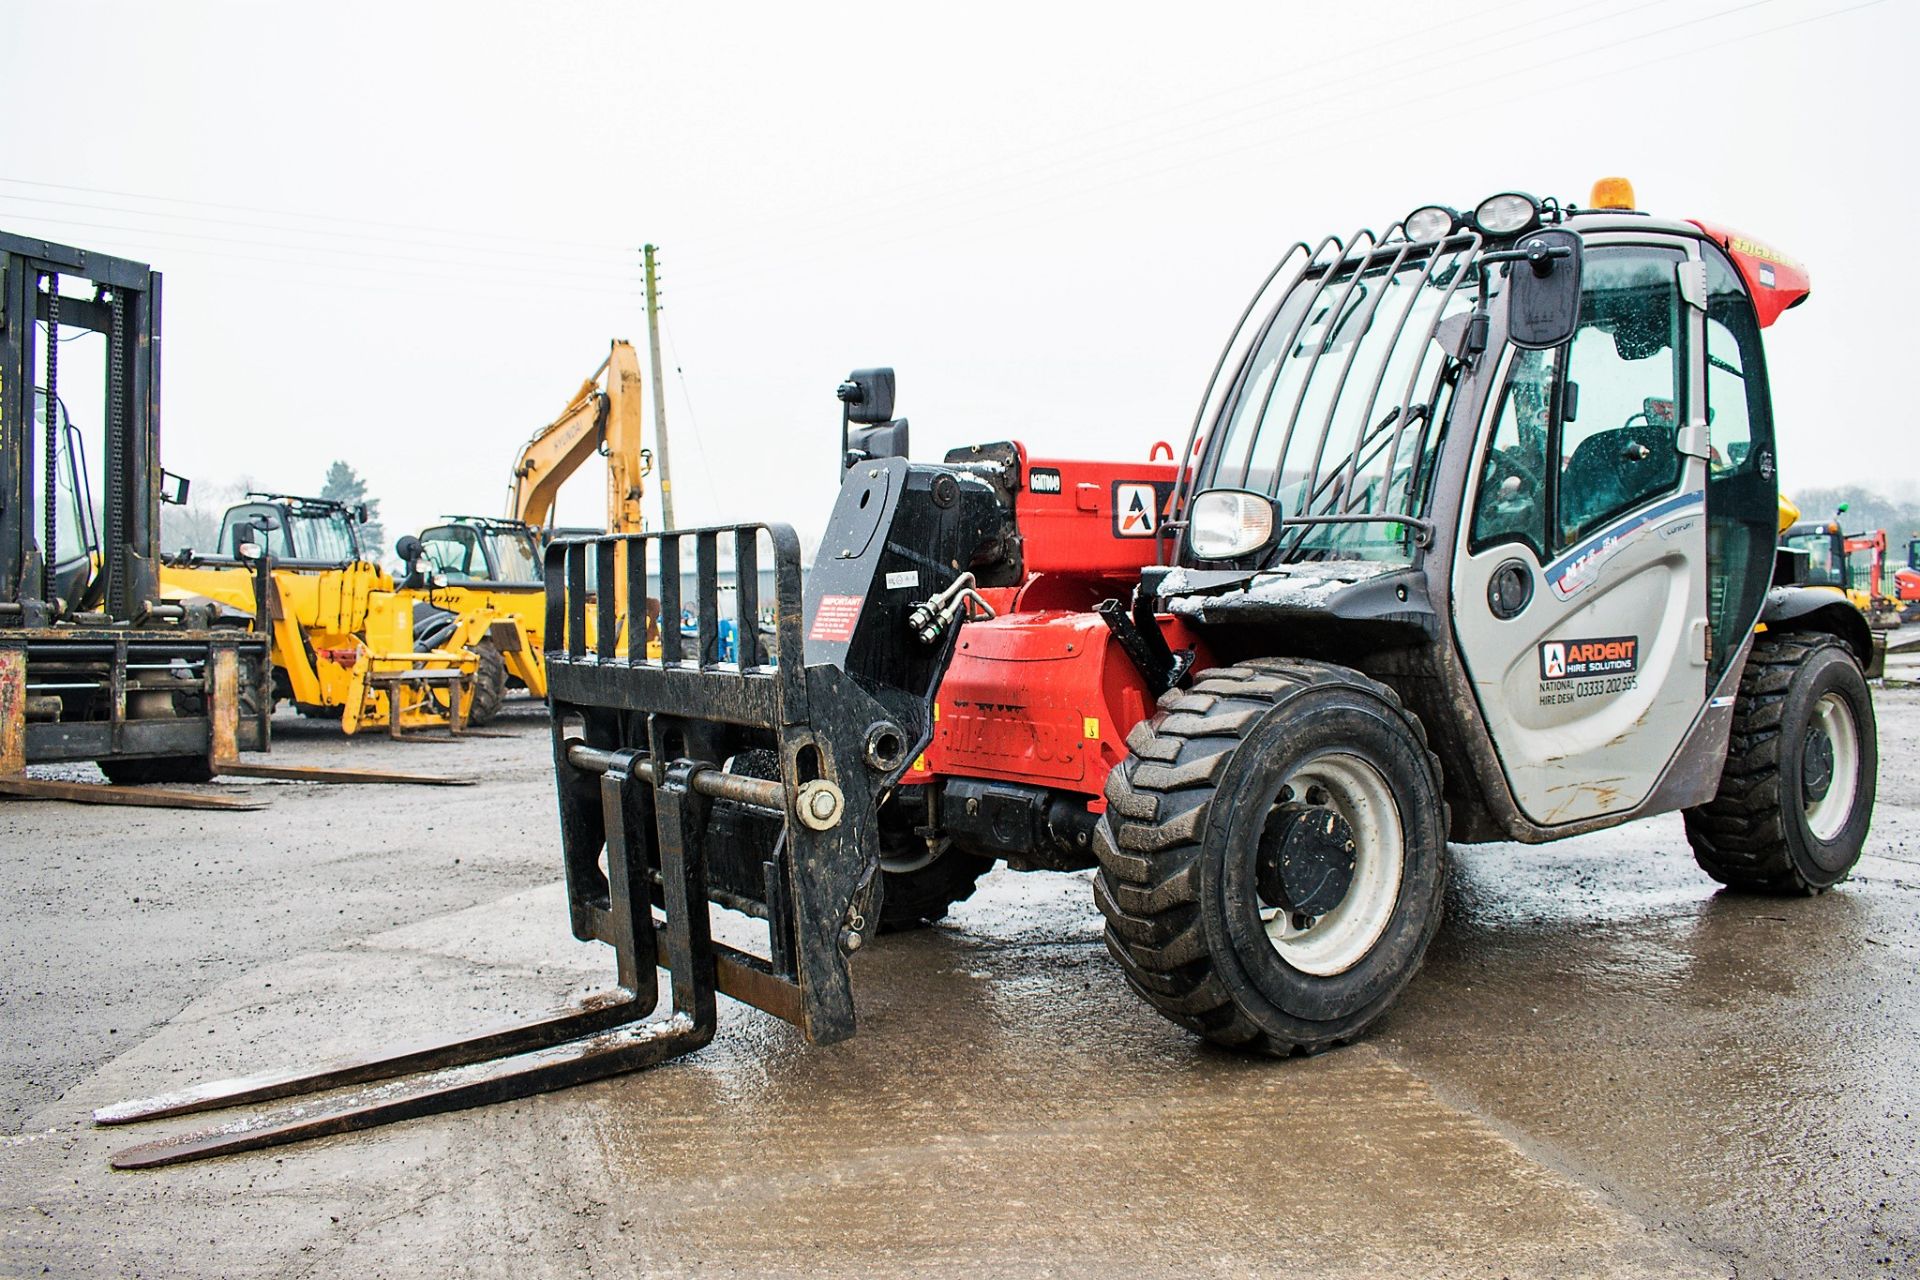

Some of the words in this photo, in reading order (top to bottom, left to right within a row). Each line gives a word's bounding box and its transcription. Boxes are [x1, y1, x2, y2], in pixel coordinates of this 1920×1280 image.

[822, 597, 863, 606] IMPORTANT
[1567, 641, 1636, 663] ARDENT
[1567, 663, 1586, 673] HIRE
[1589, 659, 1632, 672] SOLUTIONS
[1540, 680, 1575, 692] NATIONAL
[1577, 680, 1604, 698] 03333
[1606, 678, 1621, 694] 202
[1540, 694, 1556, 705] HIRE
[1557, 693, 1575, 704] DESK
